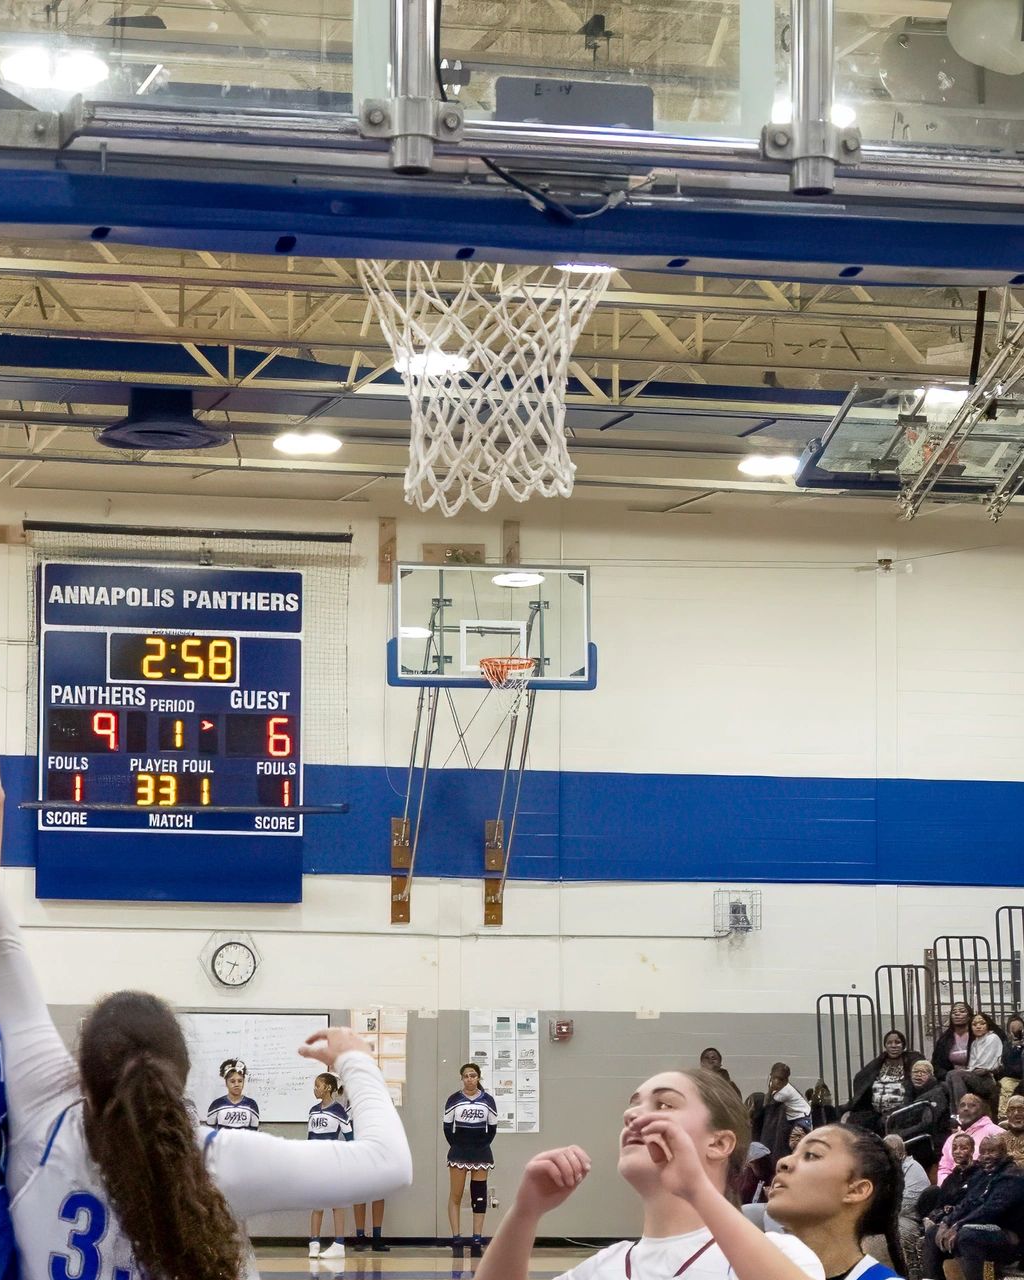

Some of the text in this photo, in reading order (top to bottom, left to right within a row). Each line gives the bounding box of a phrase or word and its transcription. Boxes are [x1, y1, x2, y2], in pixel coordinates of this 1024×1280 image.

[48, 585, 299, 612] ANNAPOLIS PANTHERS
[142, 637, 232, 681] 2:58
[51, 684, 146, 706] PANTHERS
[150, 699, 195, 713] PERIOD
[230, 689, 290, 710] GUEST
[92, 711, 116, 750] 9
[175, 719, 183, 748] 1
[267, 717, 291, 757] 6
[48, 756, 89, 771] FOULS
[129, 758, 214, 774] PLAYER FOUL
[256, 761, 296, 776] FOULS
[75, 775, 82, 802] 1
[136, 774, 177, 806] 33
[201, 778, 210, 806] 1
[283, 780, 290, 807] 1
[46, 811, 88, 826] SCORE
[149, 813, 193, 829] MATCH
[254, 816, 295, 831] SCORE
